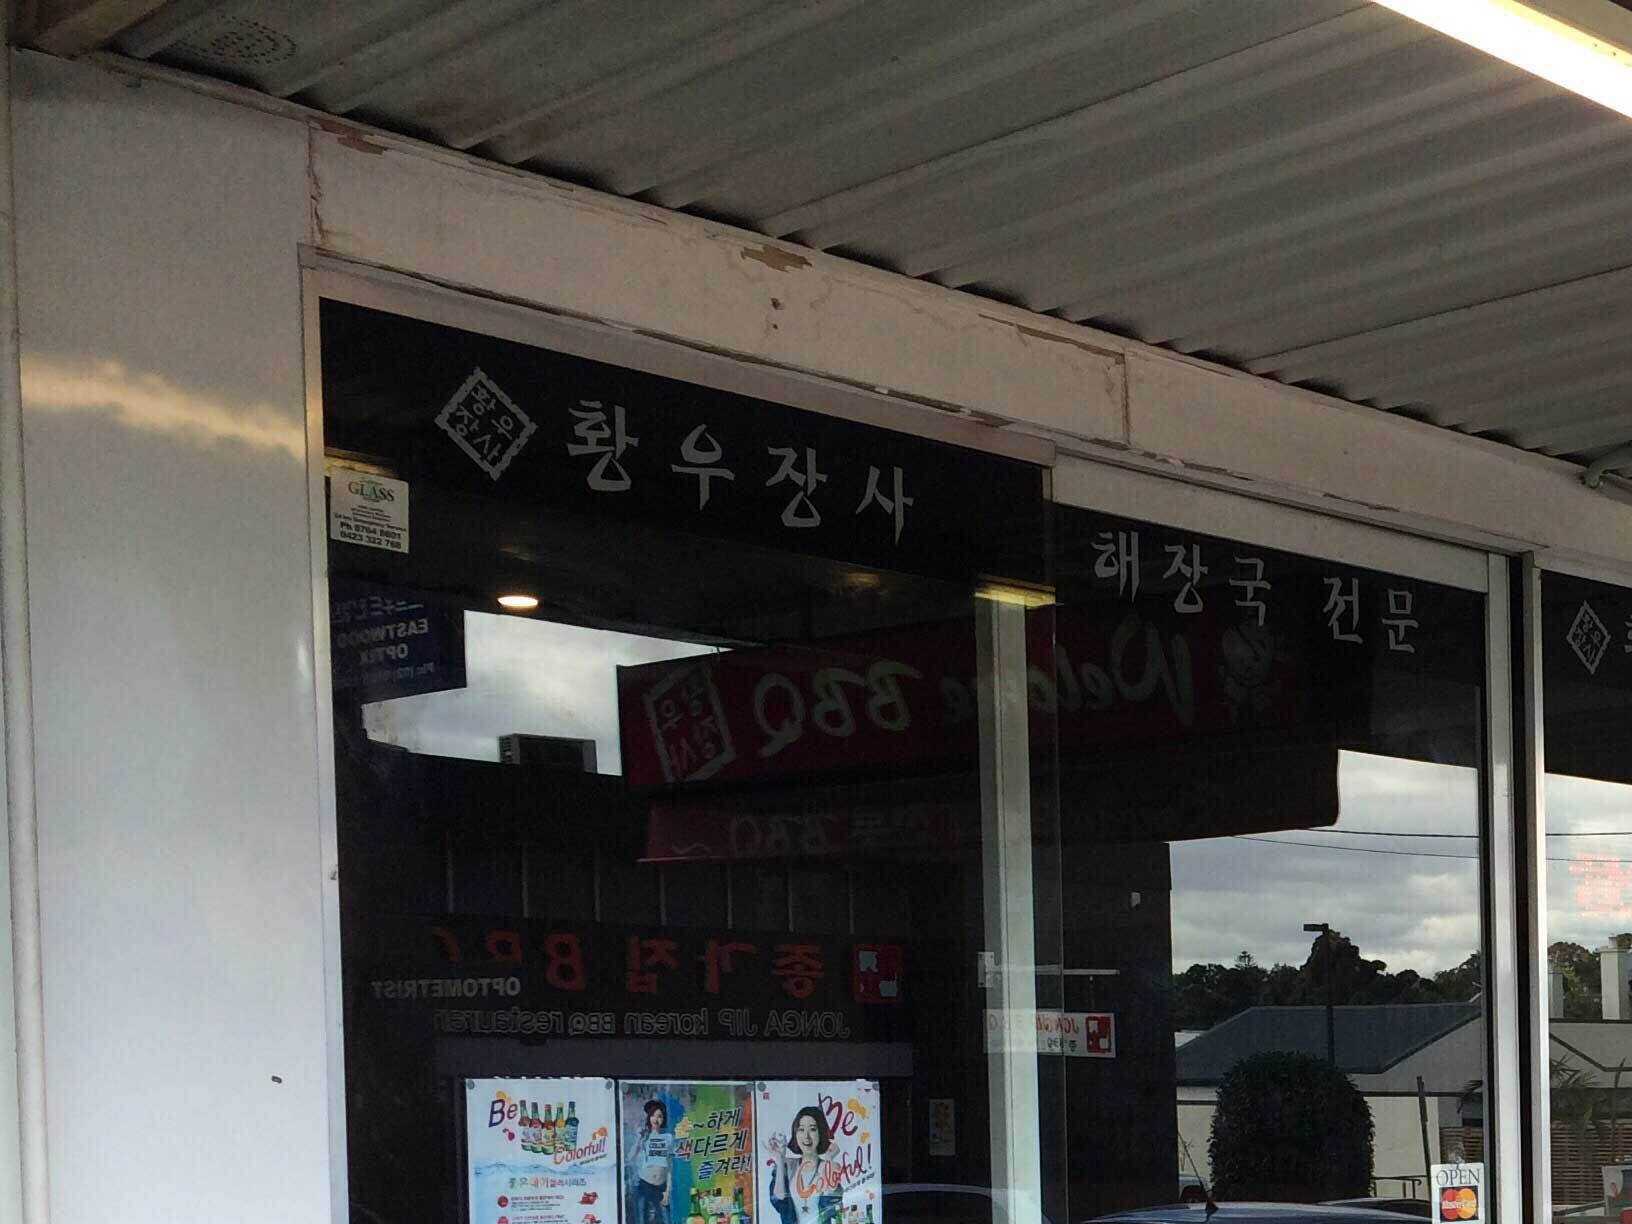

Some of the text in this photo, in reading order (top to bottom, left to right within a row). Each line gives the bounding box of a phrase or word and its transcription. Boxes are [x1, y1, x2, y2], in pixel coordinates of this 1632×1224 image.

[566, 399, 914, 546] 황우장사
[348, 480, 395, 502] GLASS
[1091, 530, 1421, 655] 해장국 전문
[488, 1098, 518, 1128] Be
[818, 1092, 858, 1140] Be
[553, 1137, 607, 1166] Colorful!
[674, 1130, 748, 1161] 색다르게
[698, 1155, 752, 1181] 즐겨라!
[1436, 1168, 1480, 1187] OPEN
